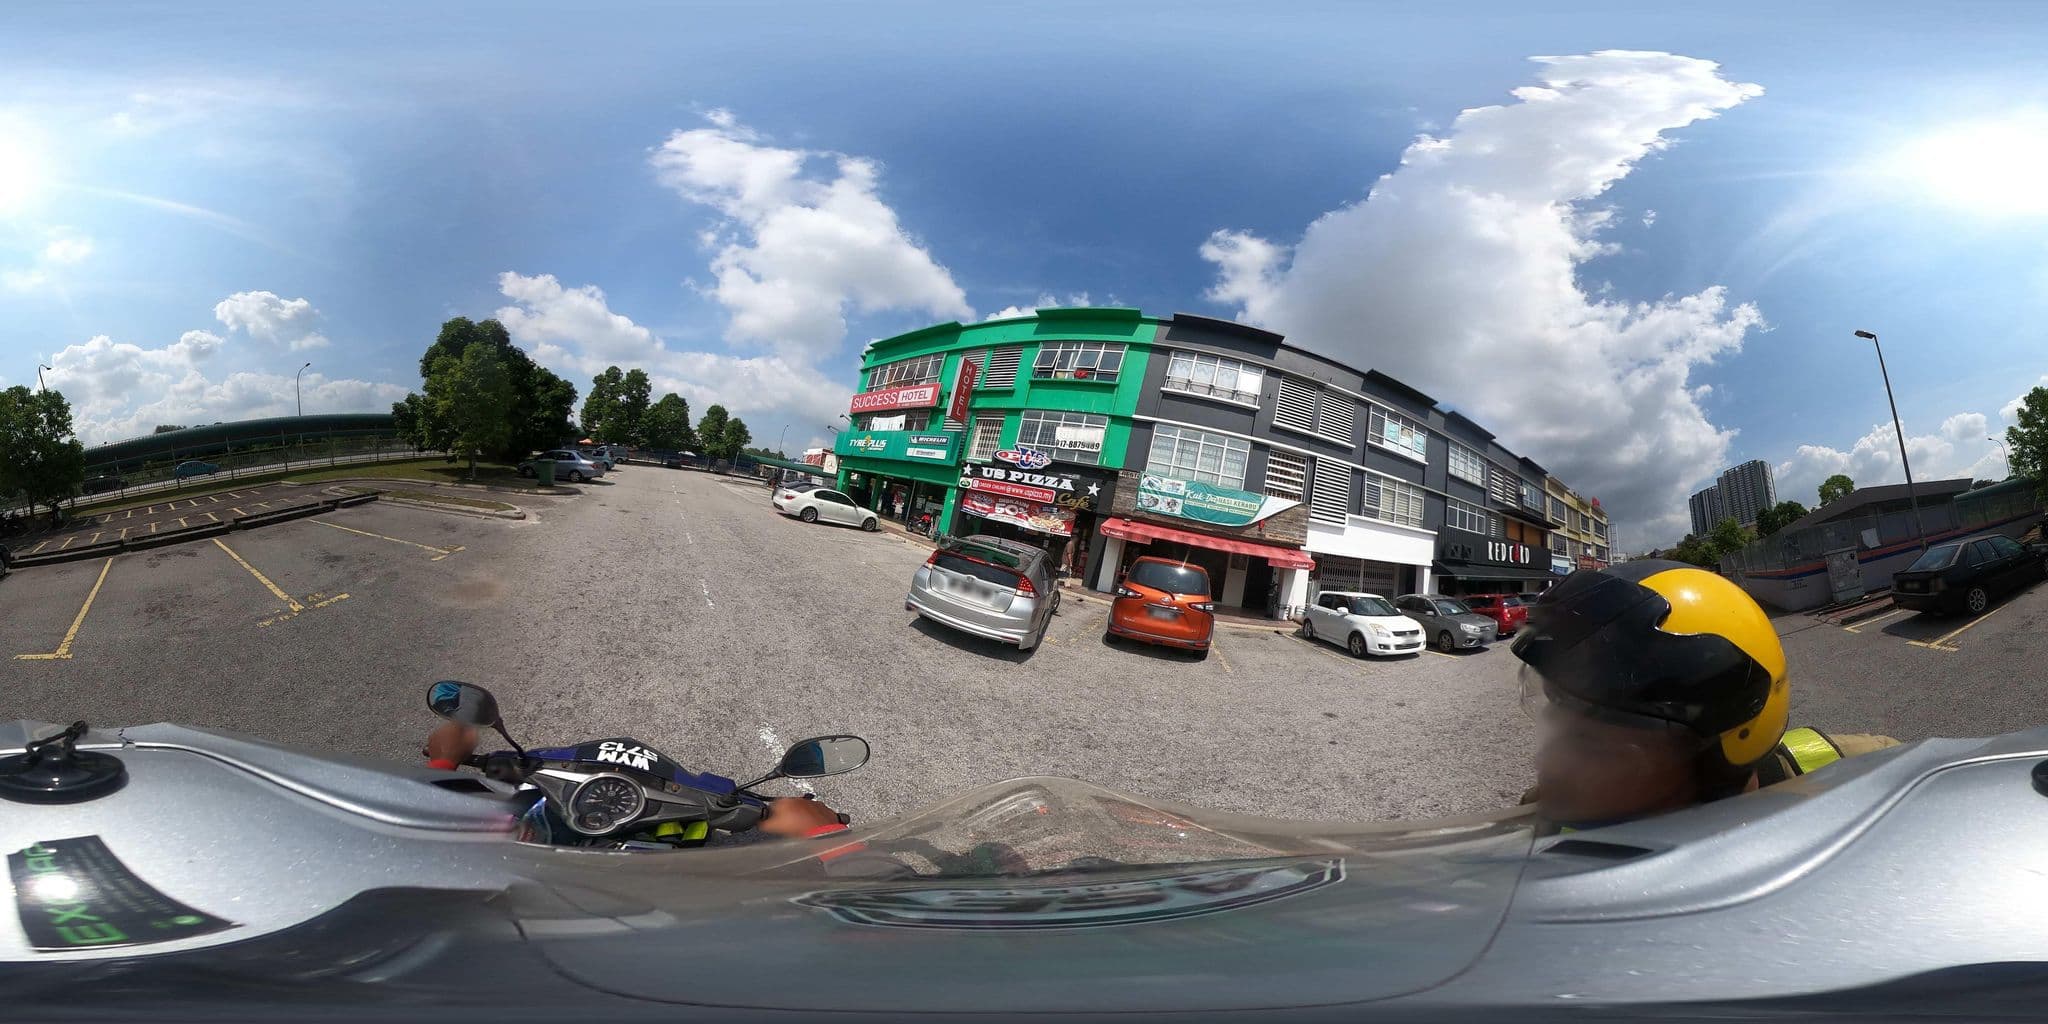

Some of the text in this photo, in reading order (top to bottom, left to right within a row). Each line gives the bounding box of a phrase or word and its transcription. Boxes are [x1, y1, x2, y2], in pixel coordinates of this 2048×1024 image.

[853, 392, 897, 409] SUCCESS
[901, 390, 929, 401] HOTEL
[956, 365, 973, 416] HOTEL
[982, 467, 1006, 480] US
[1008, 471, 1075, 491] PIZZA
[1487, 541, 1508, 562] RED
[596, 749, 650, 771] WYM
[598, 741, 658, 762] 5713
